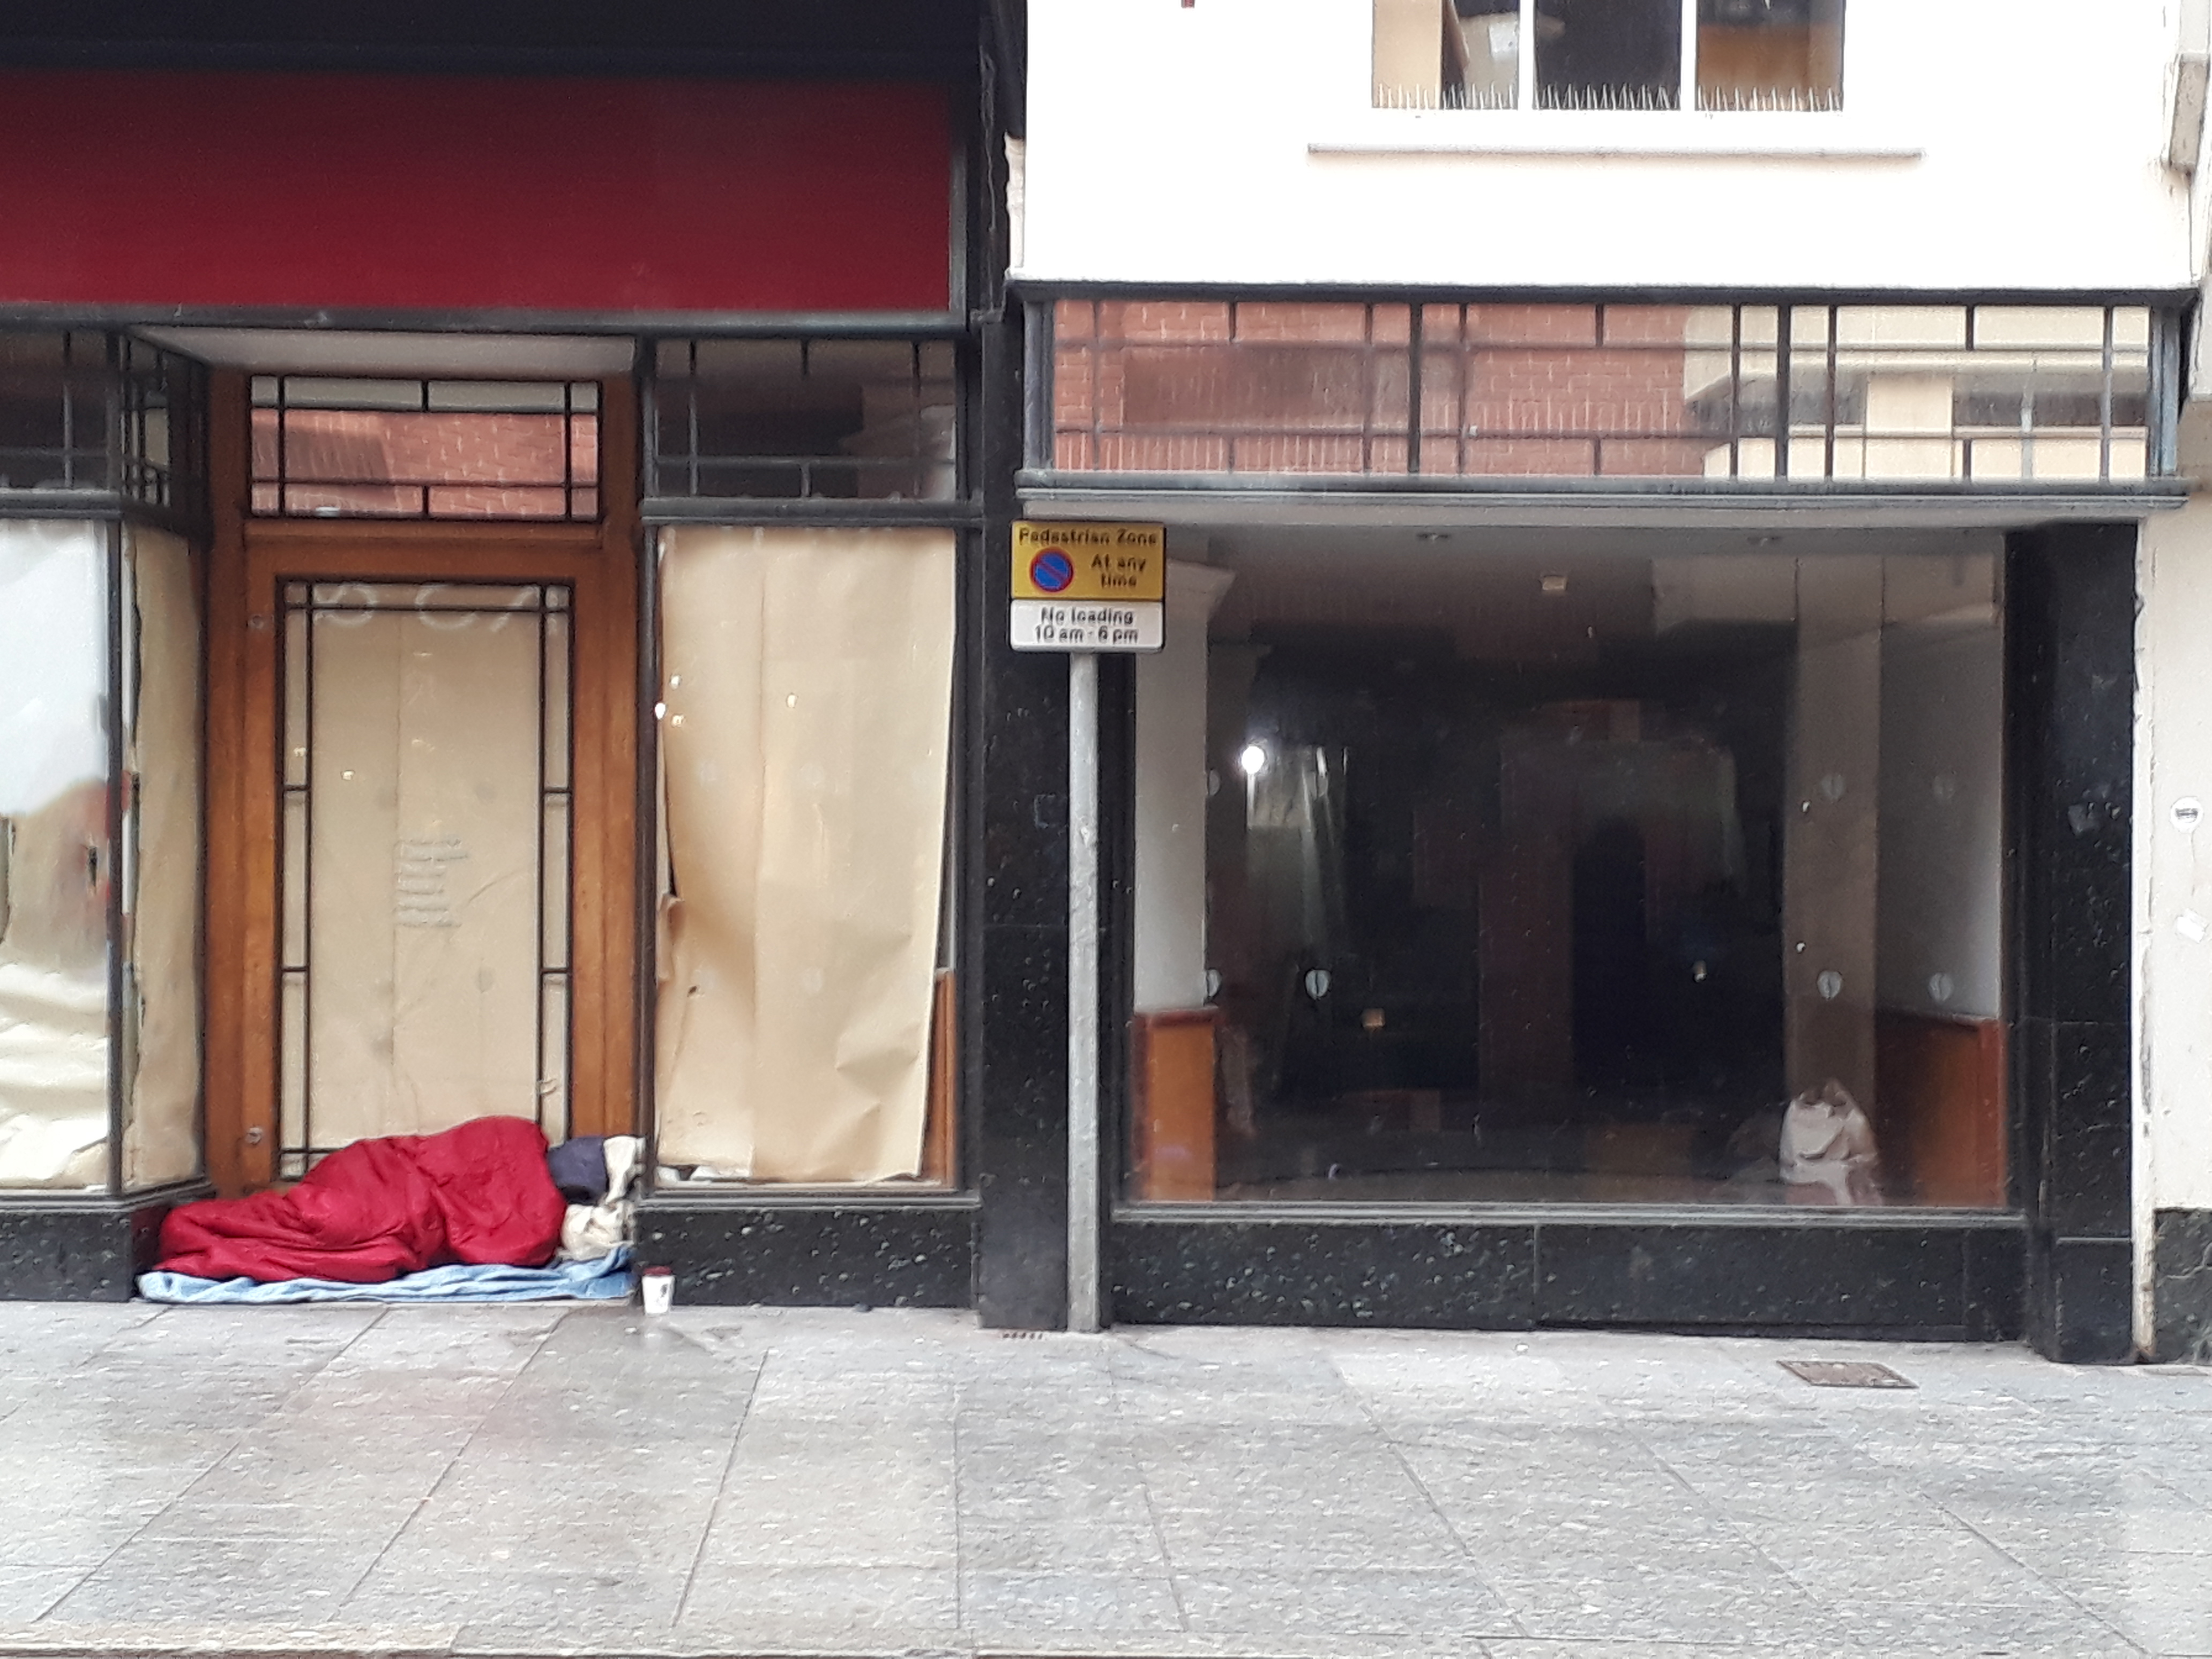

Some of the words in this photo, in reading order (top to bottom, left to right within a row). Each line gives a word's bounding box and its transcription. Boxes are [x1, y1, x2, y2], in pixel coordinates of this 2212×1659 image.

[1019, 527, 1110, 545] Pedestrian
[1117, 528, 1156, 544] Zone
[1091, 554, 1110, 570] At
[1118, 557, 1146, 572] any
[1101, 573, 1137, 588] time
[1041, 607, 1065, 624] No
[1072, 607, 1133, 625] loading
[1035, 625, 1055, 642] 10
[1058, 628, 1083, 642] am
[1112, 628, 1139, 644] pm
